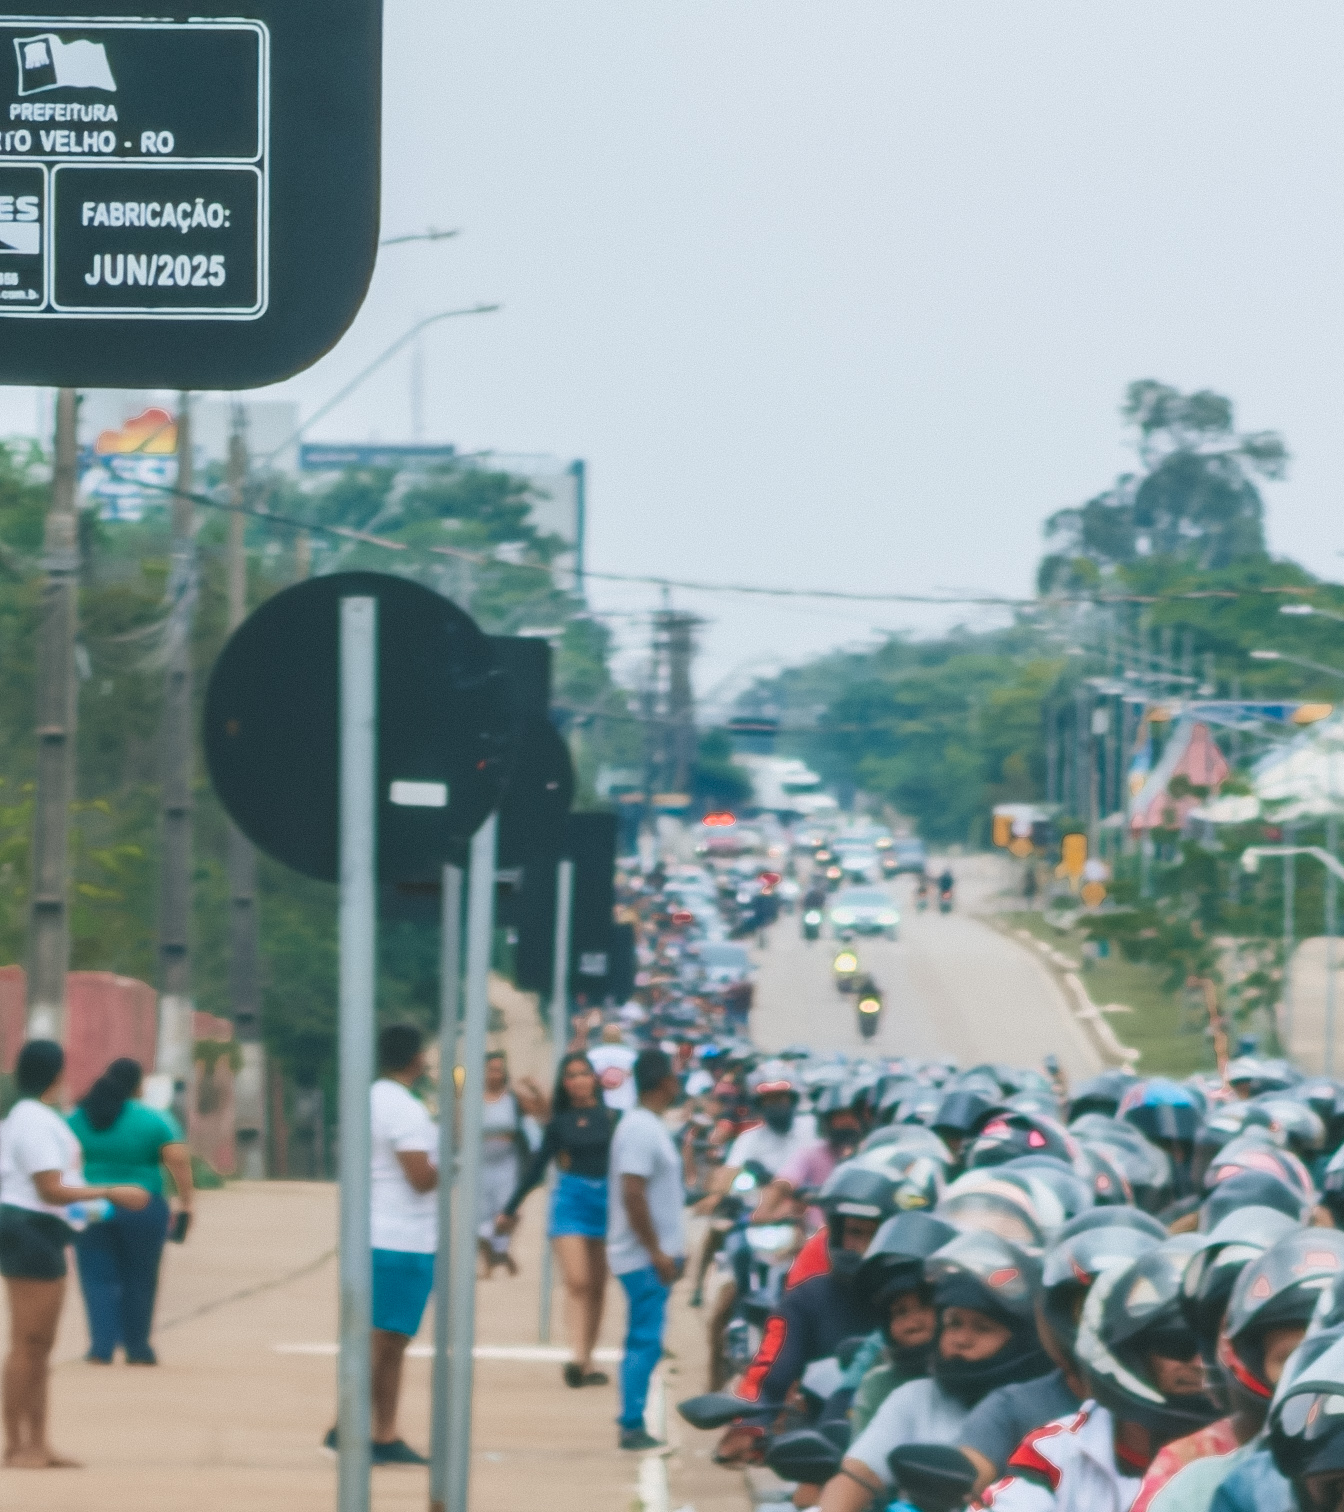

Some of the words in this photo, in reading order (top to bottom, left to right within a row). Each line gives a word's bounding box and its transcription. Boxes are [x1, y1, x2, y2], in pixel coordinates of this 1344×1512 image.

[10, 103, 118, 122] PREFEITURA
[0, 129, 32, 152] TO
[40, 130, 116, 153] VELHO
[141, 131, 175, 153] RO
[82, 198, 231, 233] FABRICAÇÃO:
[85, 254, 226, 286] JUN/2025
